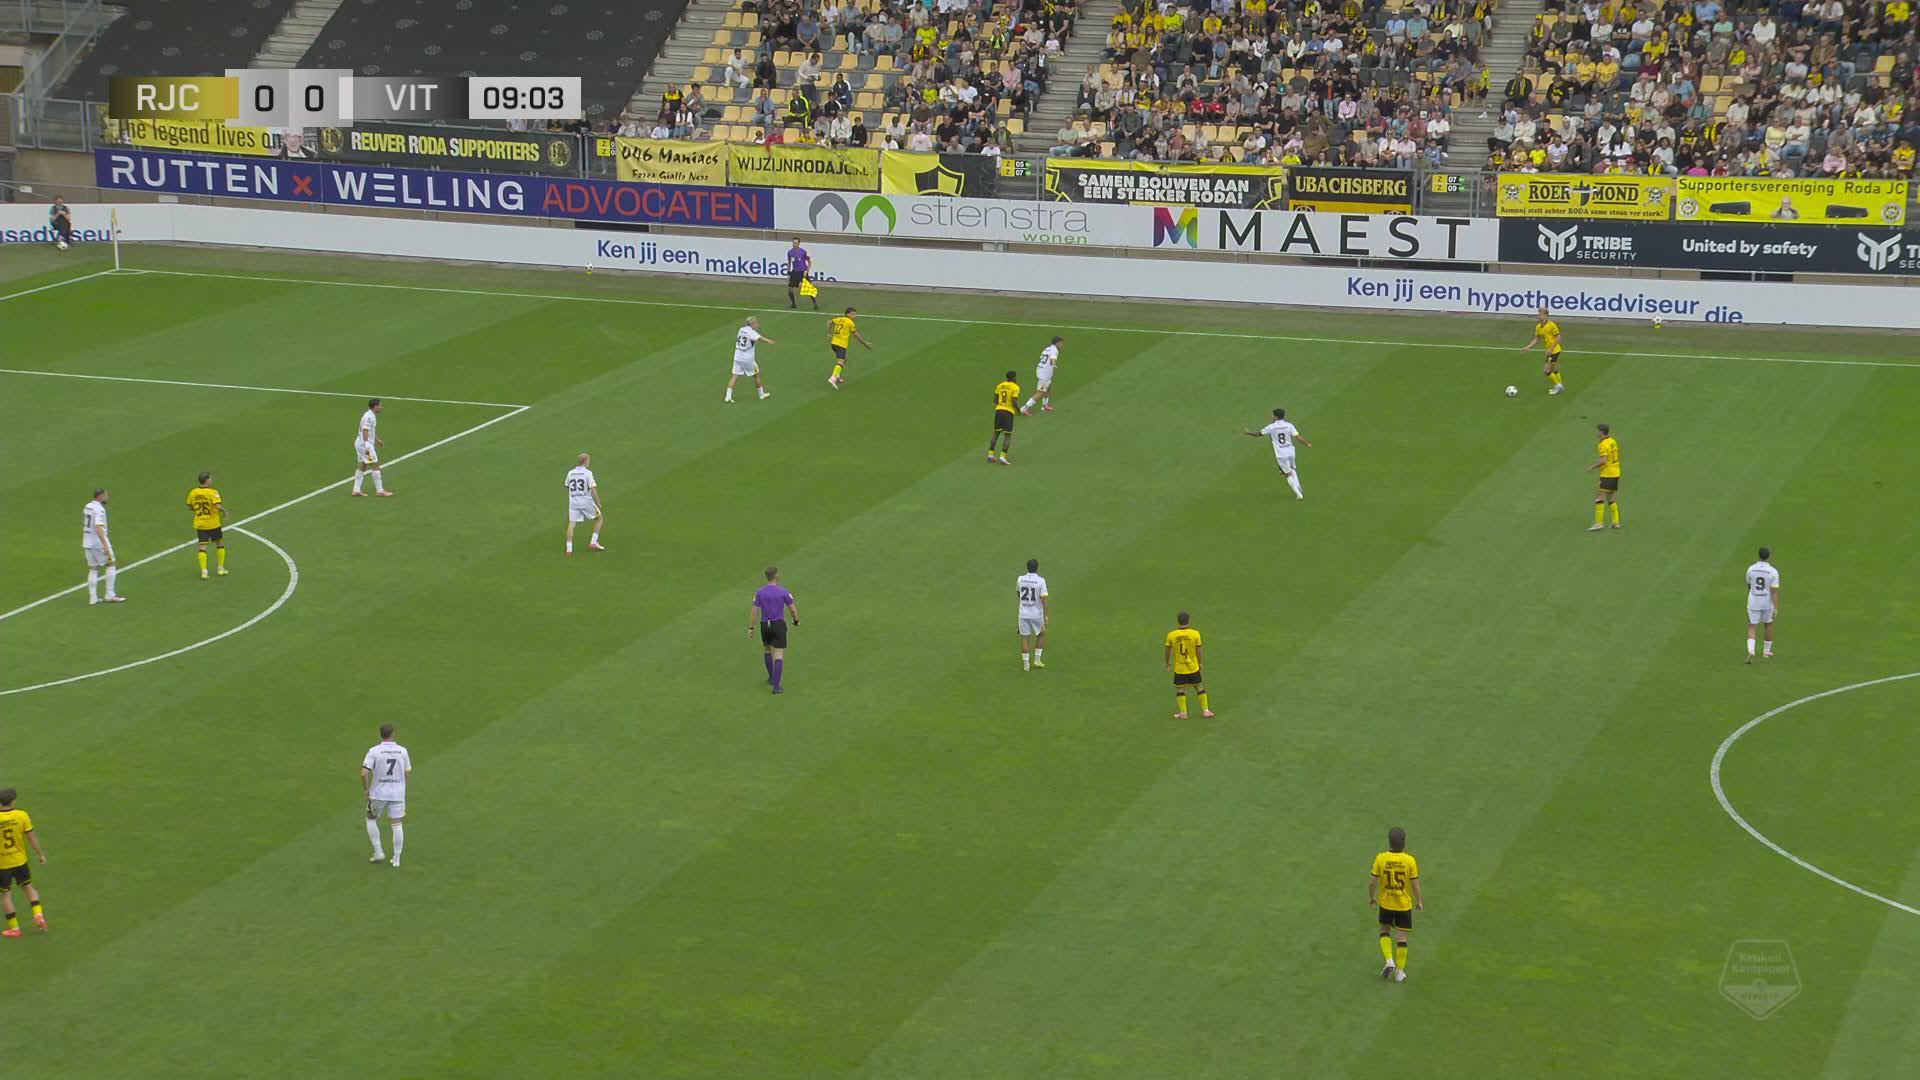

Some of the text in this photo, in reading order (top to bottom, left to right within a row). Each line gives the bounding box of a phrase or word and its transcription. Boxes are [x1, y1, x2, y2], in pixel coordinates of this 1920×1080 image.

[153, 119, 210, 146] legend
[216, 124, 255, 149] lives
[351, 131, 540, 162] REUVER RODA SUPPORTERS
[659, 147, 719, 166] Maniacs
[111, 155, 279, 195] RUTTEN
[332, 170, 525, 211] WELLING
[543, 183, 758, 224] ADVOCATEN
[1078, 173, 1249, 193] SAMEN BOUWEN AAN
[1295, 175, 1408, 196] UBACHSBERG
[1679, 178, 1905, 196] Supportersvereniging Roda JC
[1083, 186, 1243, 204] EEN STERKER RODA!
[1528, 185, 1639, 202] ROER MOND
[911, 198, 1090, 233] stienstra
[1023, 232, 1088, 245] wonen
[1219, 209, 1471, 260] MAEST
[1582, 235, 1633, 251] TRIBE
[597, 239, 636, 258] Ken
[639, 241, 657, 265] jij
[662, 249, 700, 265] een
[705, 256, 790, 276] makelaa
[1576, 250, 1637, 261] SECURITY
[1682, 238, 1818, 259] United by safety
[1346, 276, 1743, 324] Ken jij een hypotheekadviseur die
[1277, 432, 1286, 445] 8
[569, 478, 586, 492] 33
[1755, 576, 1766, 592] 9
[1020, 586, 1037, 602] 21
[386, 758, 397, 776] 7
[3, 828, 16, 850] 5
[1383, 870, 1406, 891] 15
